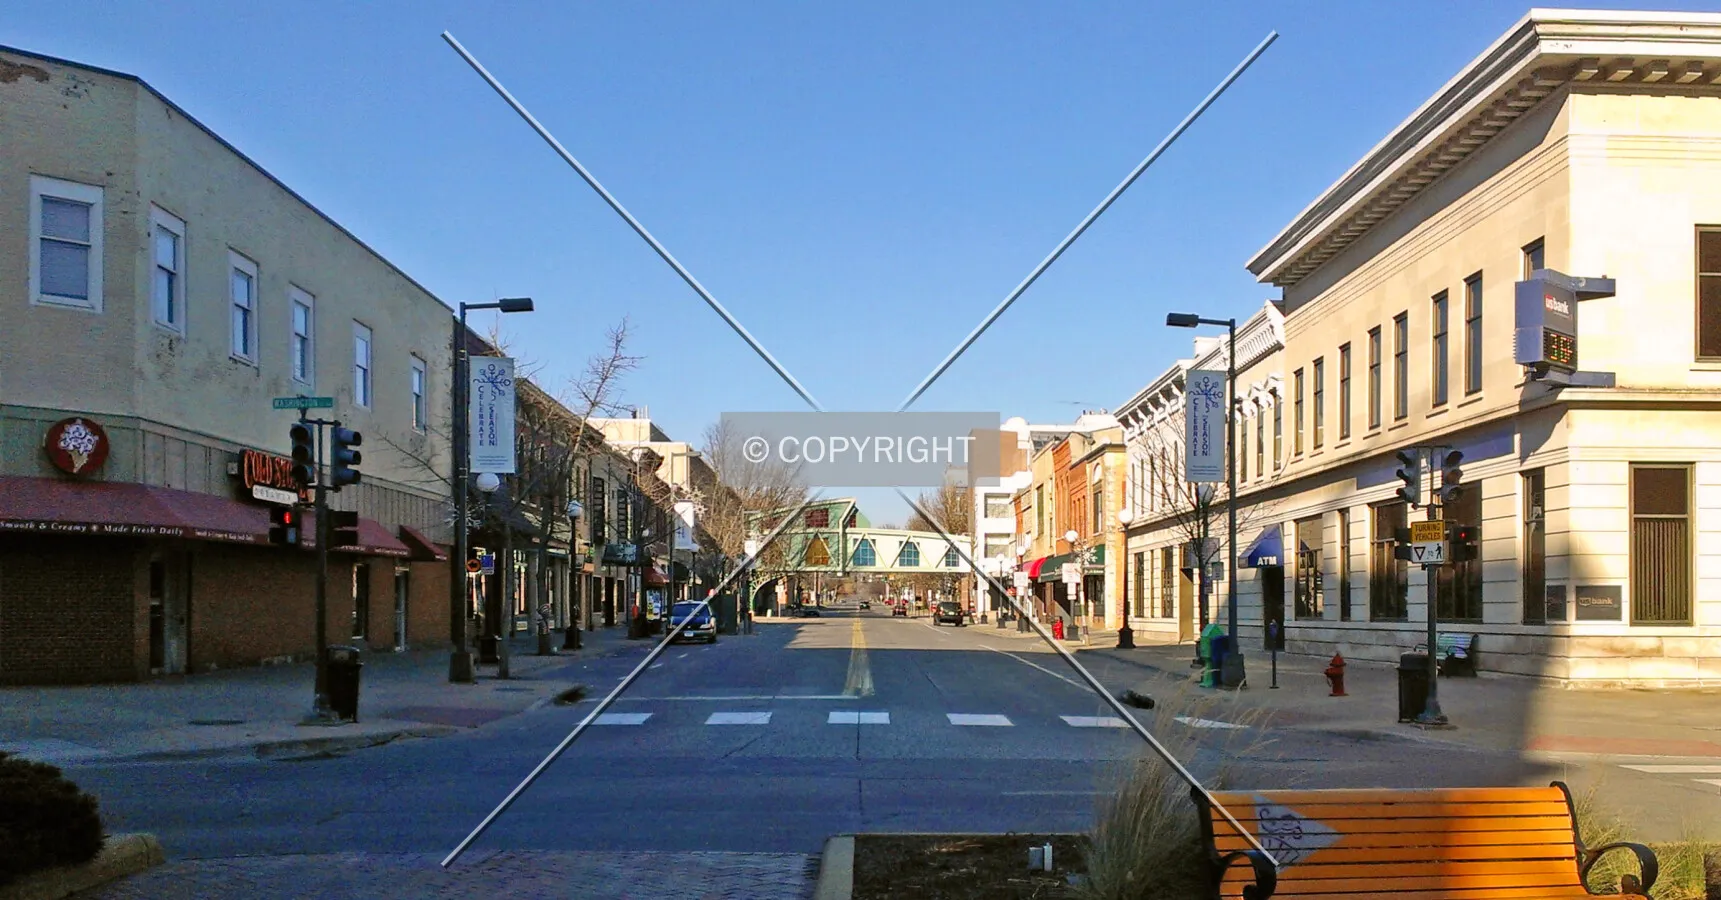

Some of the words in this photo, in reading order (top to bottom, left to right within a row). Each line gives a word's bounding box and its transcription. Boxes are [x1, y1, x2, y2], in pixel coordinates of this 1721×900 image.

[274, 398, 318, 409] WASHINGTON
[244, 448, 272, 489] COLD
[39, 522, 47, 530] &
[51, 522, 86, 532] Creamy
[104, 524, 128, 532] Made
[132, 525, 156, 534] Fresh
[160, 526, 184, 536] Daily
[1415, 523, 1441, 532] TURNING
[1415, 532, 1441, 541] VEHICLES
[1257, 556, 1277, 566] ATM
